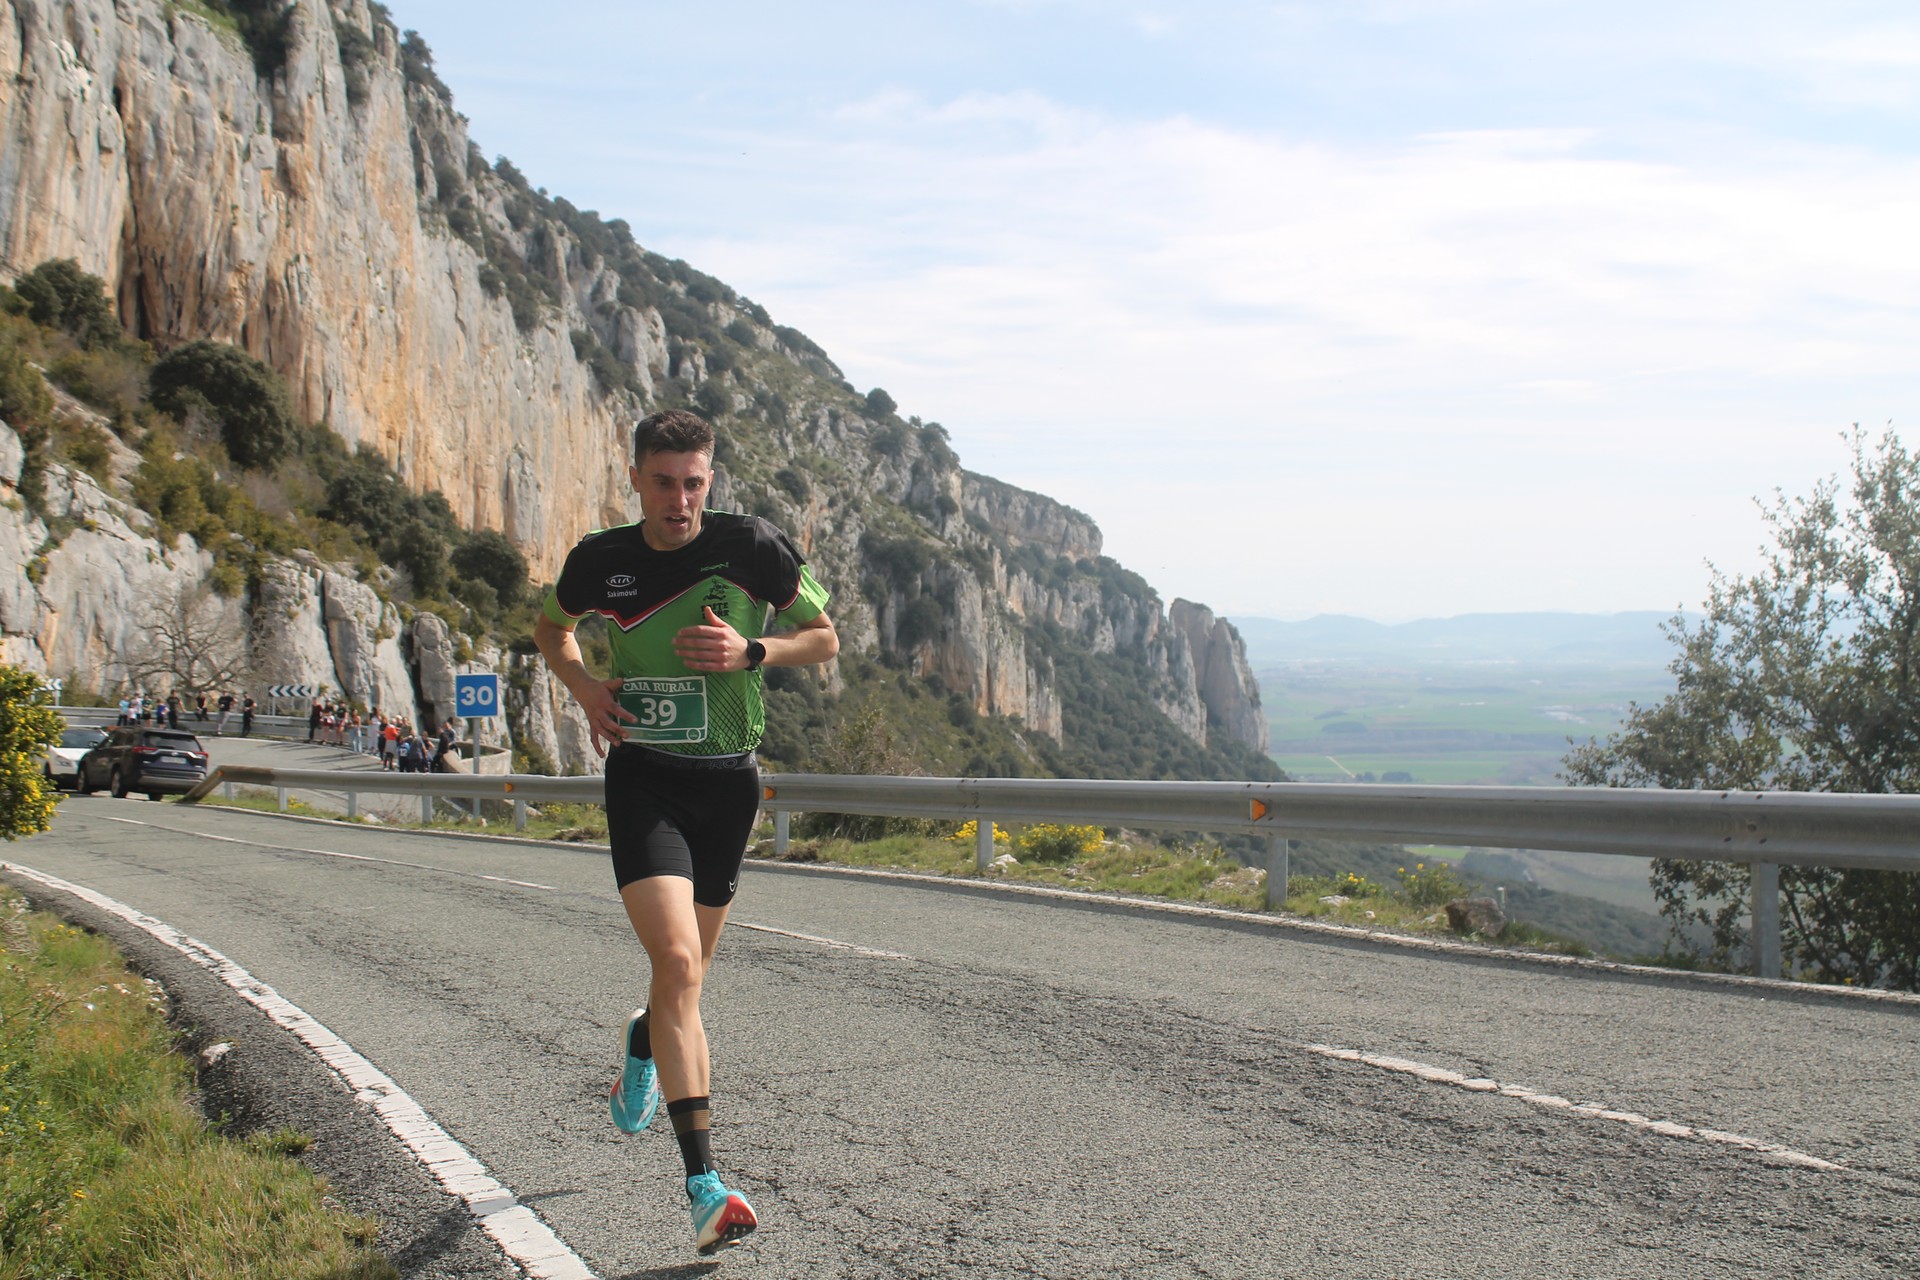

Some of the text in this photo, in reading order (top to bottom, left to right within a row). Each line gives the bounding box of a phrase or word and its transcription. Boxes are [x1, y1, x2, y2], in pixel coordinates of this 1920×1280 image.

[460, 685, 494, 706] 30
[652, 681, 695, 693] RURAL
[640, 697, 677, 726] 39
